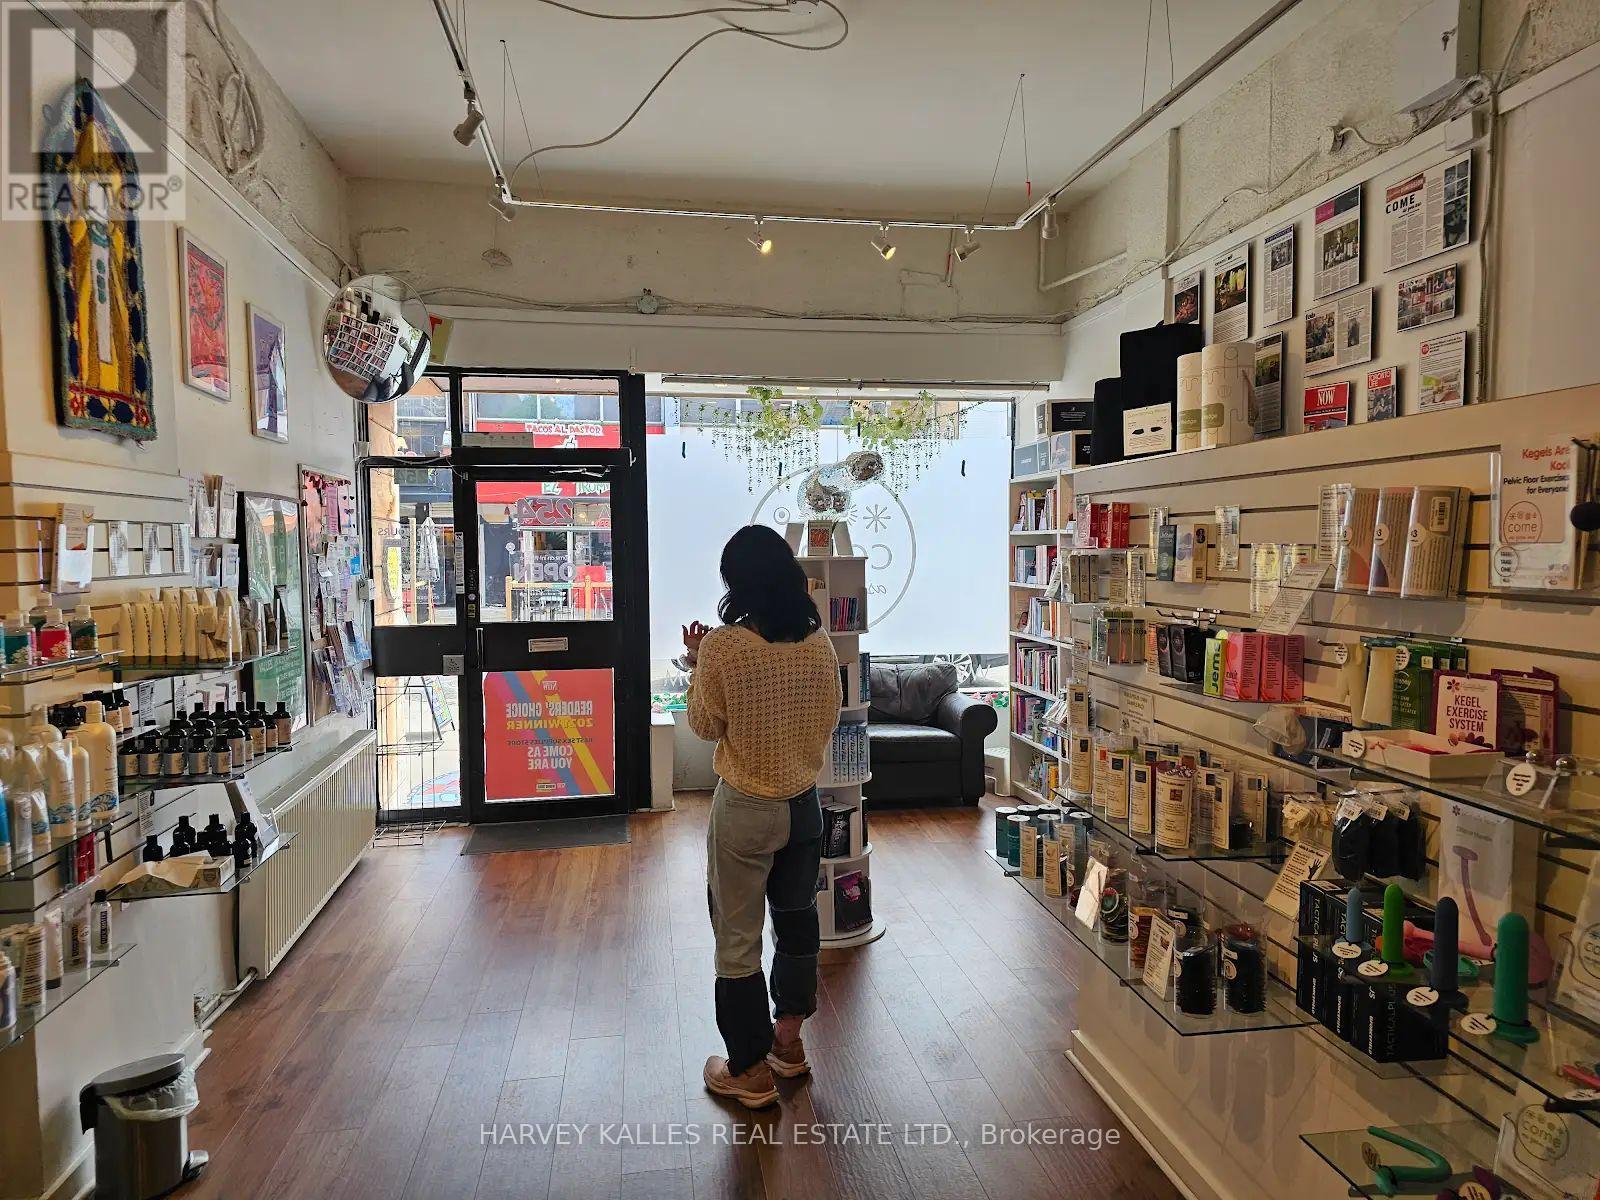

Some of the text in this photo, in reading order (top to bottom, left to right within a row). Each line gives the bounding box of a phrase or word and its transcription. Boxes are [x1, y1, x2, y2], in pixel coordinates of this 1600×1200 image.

[1385, 193, 1415, 214] COME
[1368, 368, 1392, 382] TORONTO
[1368, 379, 1379, 388] LIFE
[1317, 387, 1335, 407] NOW
[526, 425, 553, 434] TACOS
[554, 425, 567, 433] AL
[1521, 446, 1552, 461] Kegels
[1503, 475, 1522, 485] Pelvic
[1522, 474, 1539, 483] Floor
[1526, 486, 1537, 495] for
[1508, 522, 1538, 533] come
[1454, 694, 1481, 709] KEGEL
[1446, 705, 1488, 721] EXERCISE
[1449, 718, 1484, 733] SYSTEM
